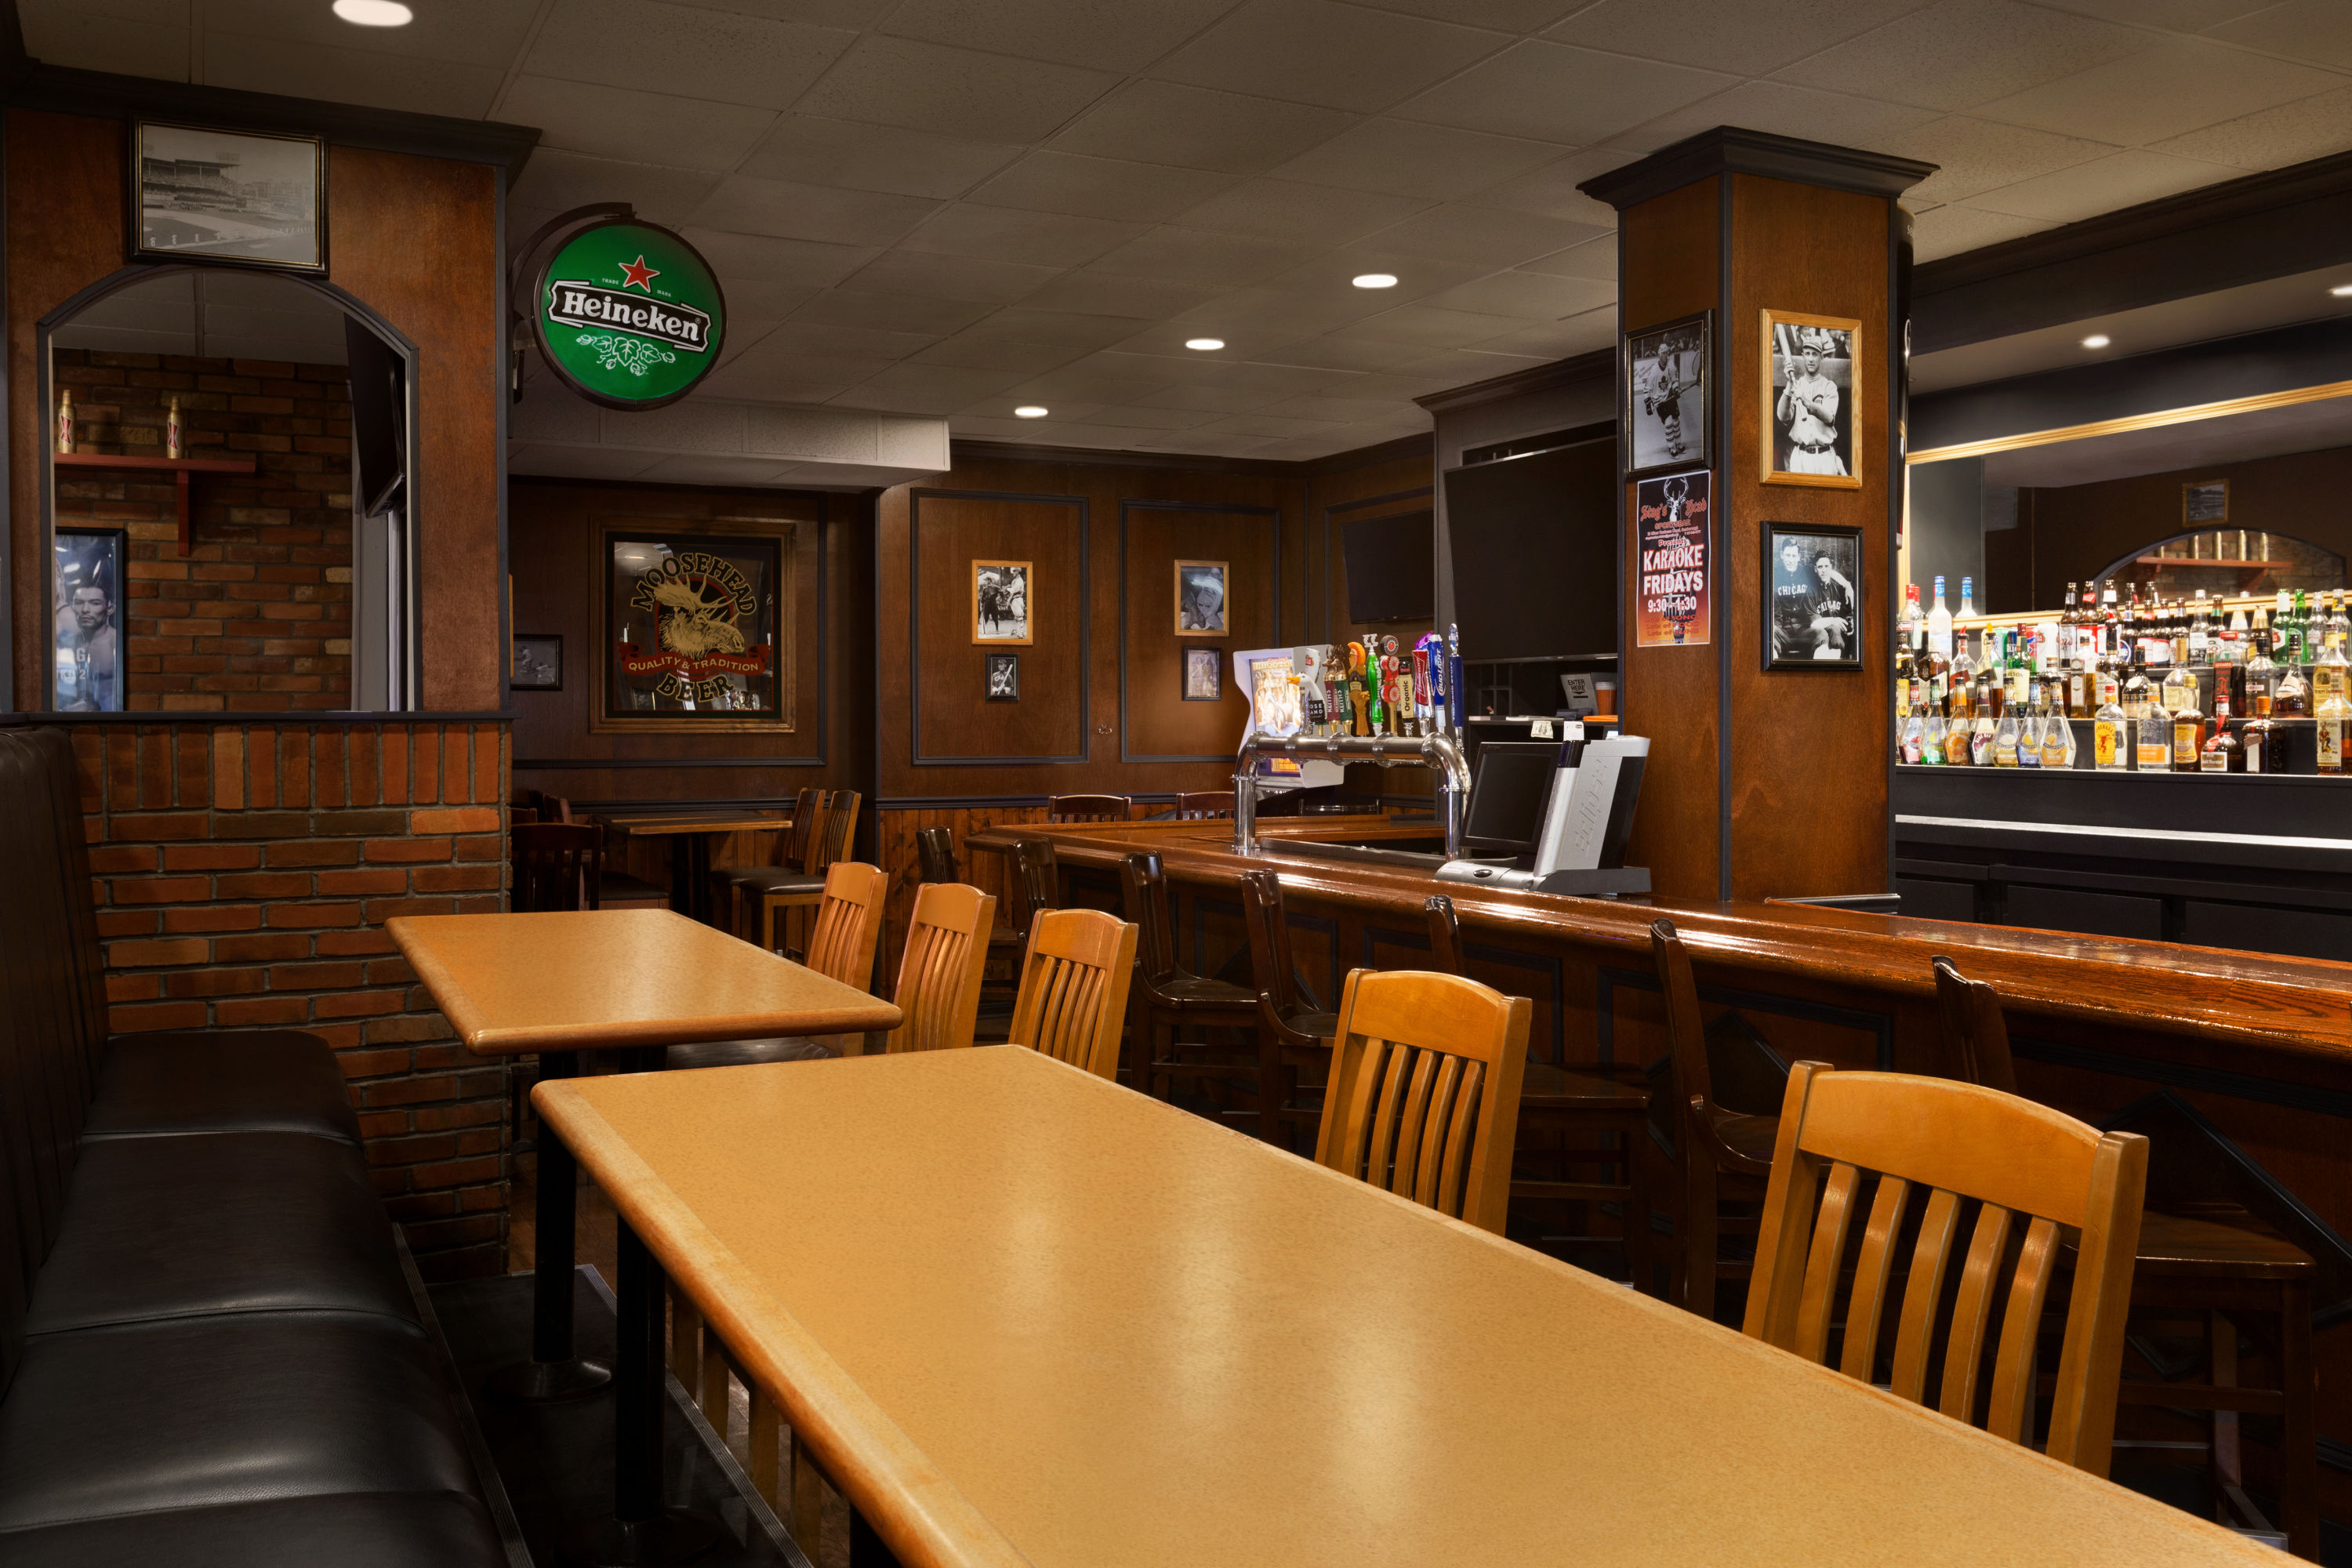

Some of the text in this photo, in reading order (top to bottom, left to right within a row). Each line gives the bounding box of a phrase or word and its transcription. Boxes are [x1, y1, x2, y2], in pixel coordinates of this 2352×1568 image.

[561, 290, 699, 342] Heineken
[1639, 497, 1708, 522] Stag's Head
[1643, 543, 1705, 572] KARAOKE
[630, 552, 757, 615] MOOSEHEAD
[1643, 570, 1704, 596] FRIDAYS
[1777, 584, 1808, 597] CHICAG
[1648, 598, 1667, 613] 9:30
[1675, 596, 1697, 611] 1:30
[628, 655, 759, 672] QUALITY & TRADITION
[656, 672, 735, 703] BEER
